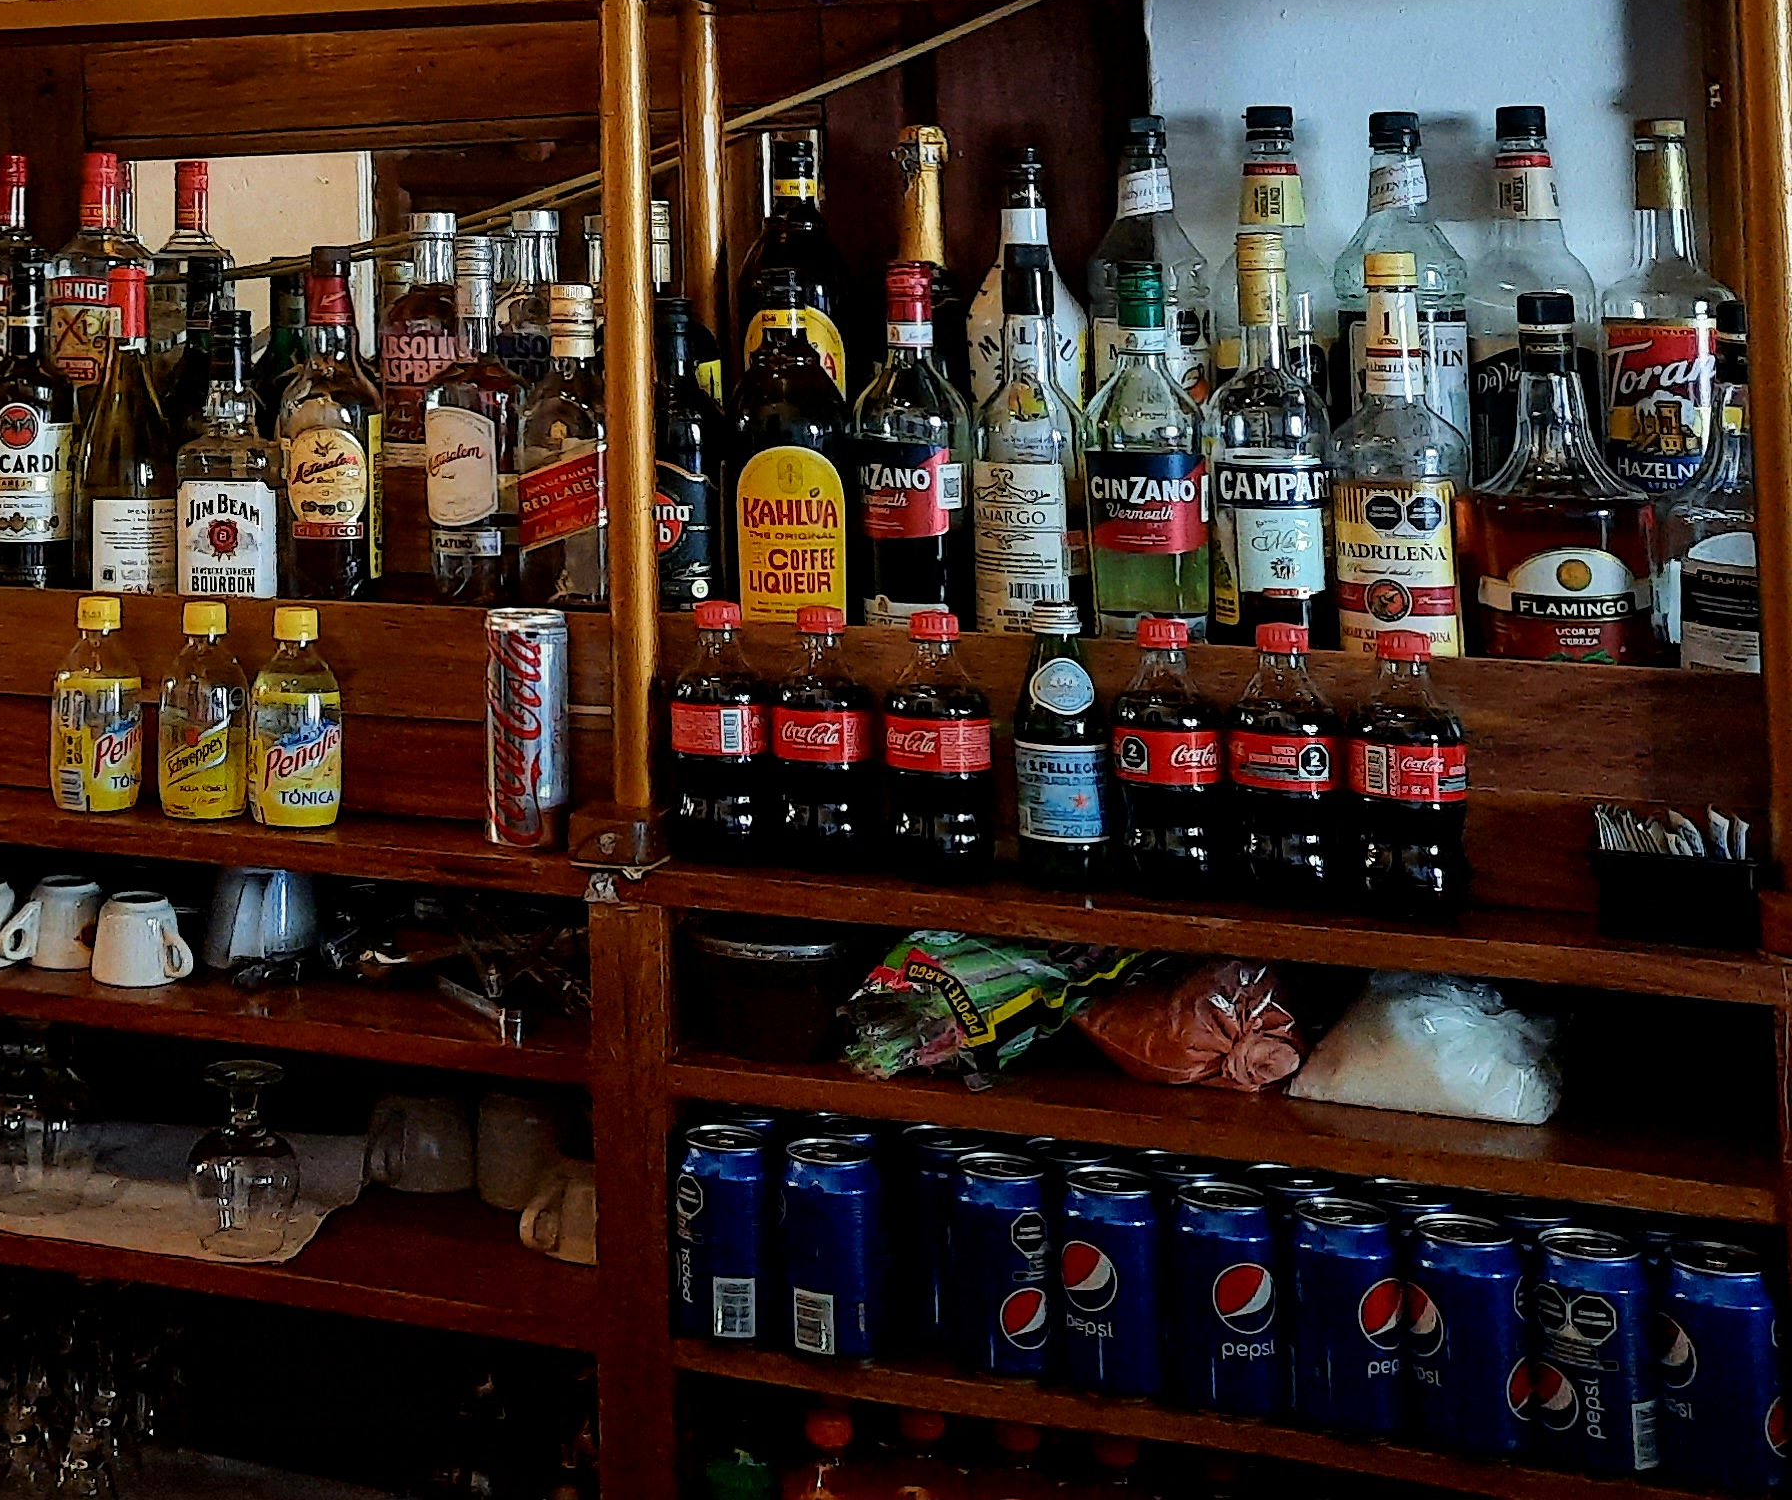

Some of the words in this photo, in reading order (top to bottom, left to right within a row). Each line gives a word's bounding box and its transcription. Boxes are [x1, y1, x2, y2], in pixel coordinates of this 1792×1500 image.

[858, 463, 931, 491] NZANO
[1616, 457, 1700, 480] HAZELN
[521, 492, 551, 514] RED
[553, 476, 603, 501] LABEL
[1090, 474, 1196, 505] CINZANO
[1219, 470, 1331, 501] CAMPARI
[185, 498, 214, 528] JIM
[216, 493, 261, 526] BEAM
[742, 487, 839, 529] KAHLÚA
[1106, 502, 1175, 522] Vermouth
[774, 532, 836, 540] ORIGINAL
[768, 548, 836, 571] COFFEE
[1337, 540, 1448, 561] MADRILEÑA
[191, 576, 256, 594] BOURBON
[749, 569, 832, 595] LIQUEUR
[1519, 600, 1629, 617] FLAMINGO
[1555, 627, 1587, 637] LICOR
[1127, 744, 1138, 757] 2
[1309, 751, 1320, 766] 2
[280, 788, 335, 806] TÓNICA
[908, 964, 955, 991] LARGO
[948, 986, 985, 1035] POPOTE
[1065, 1312, 1116, 1340] pepsi
[1221, 1339, 1275, 1360] pepsi
[1367, 1357, 1400, 1378] pep
[1586, 1377, 1608, 1440] pepsi
